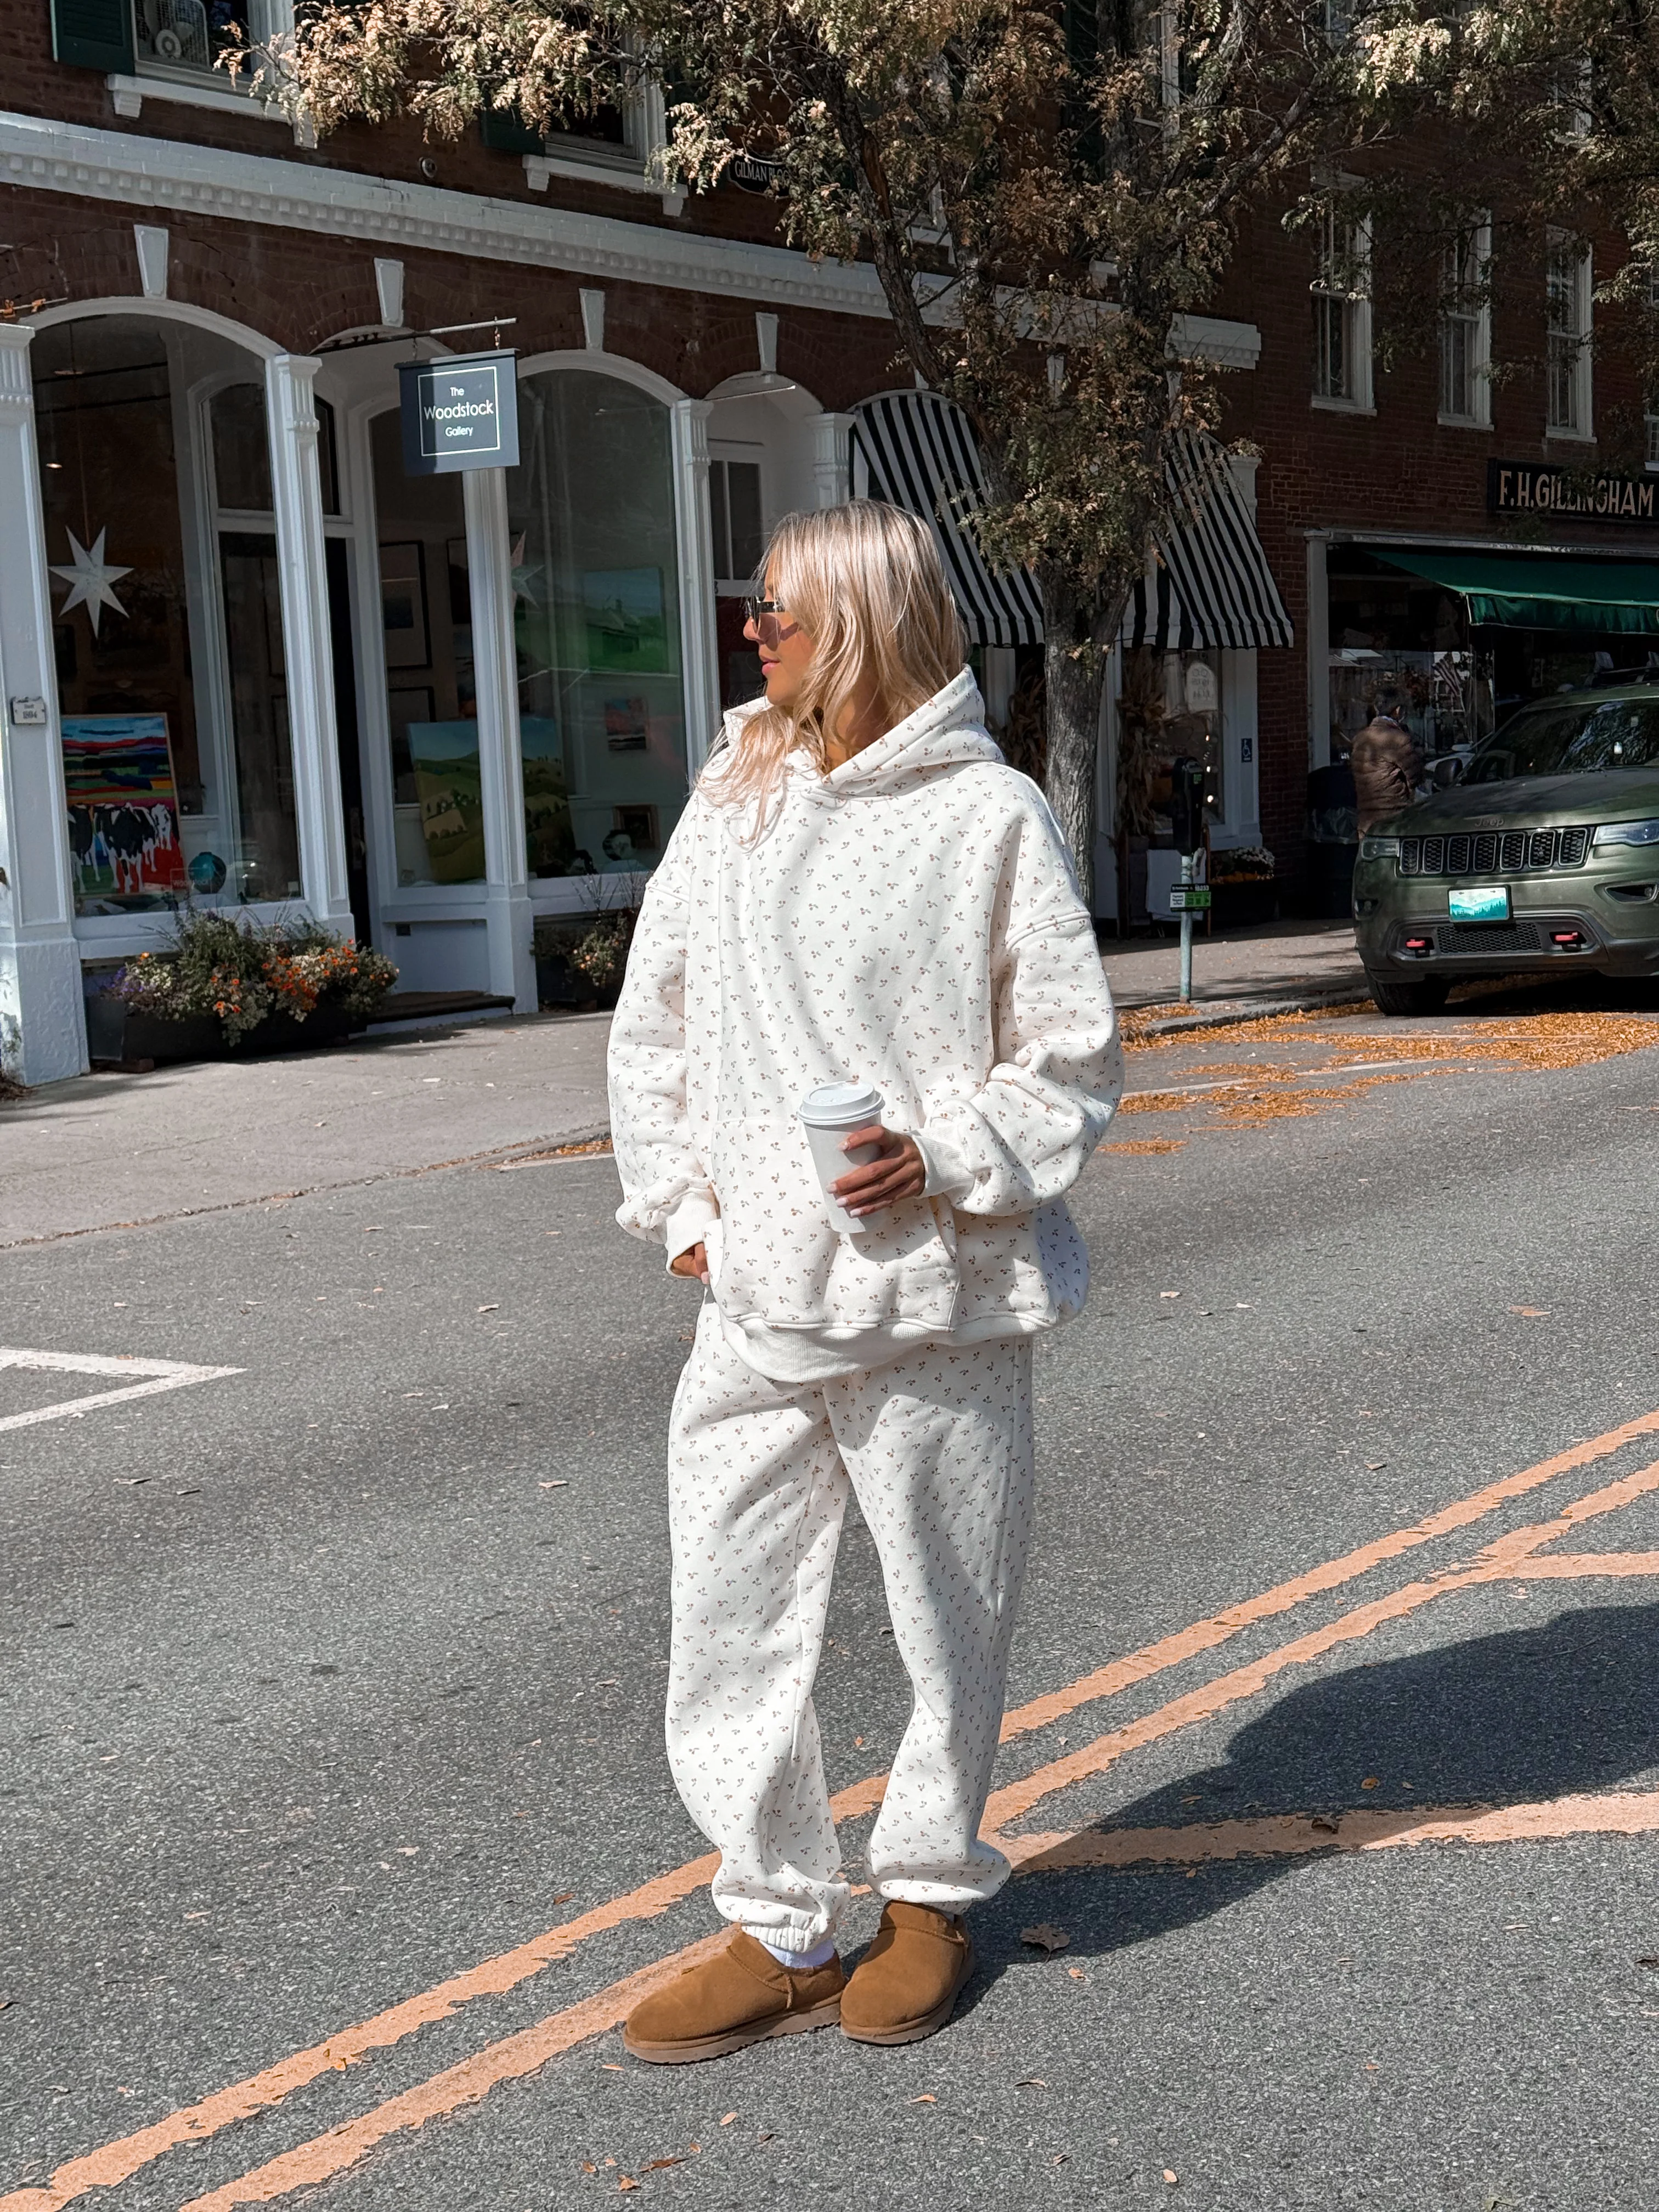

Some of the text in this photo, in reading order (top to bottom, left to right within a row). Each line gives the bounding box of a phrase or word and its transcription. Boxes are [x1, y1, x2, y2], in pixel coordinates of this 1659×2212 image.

[735, 160, 768, 182] GILMAN
[450, 387, 465, 397] The
[424, 399, 494, 420] Woodstock
[445, 426, 473, 437] Gallery
[1474, 817, 1504, 827] Jeep
